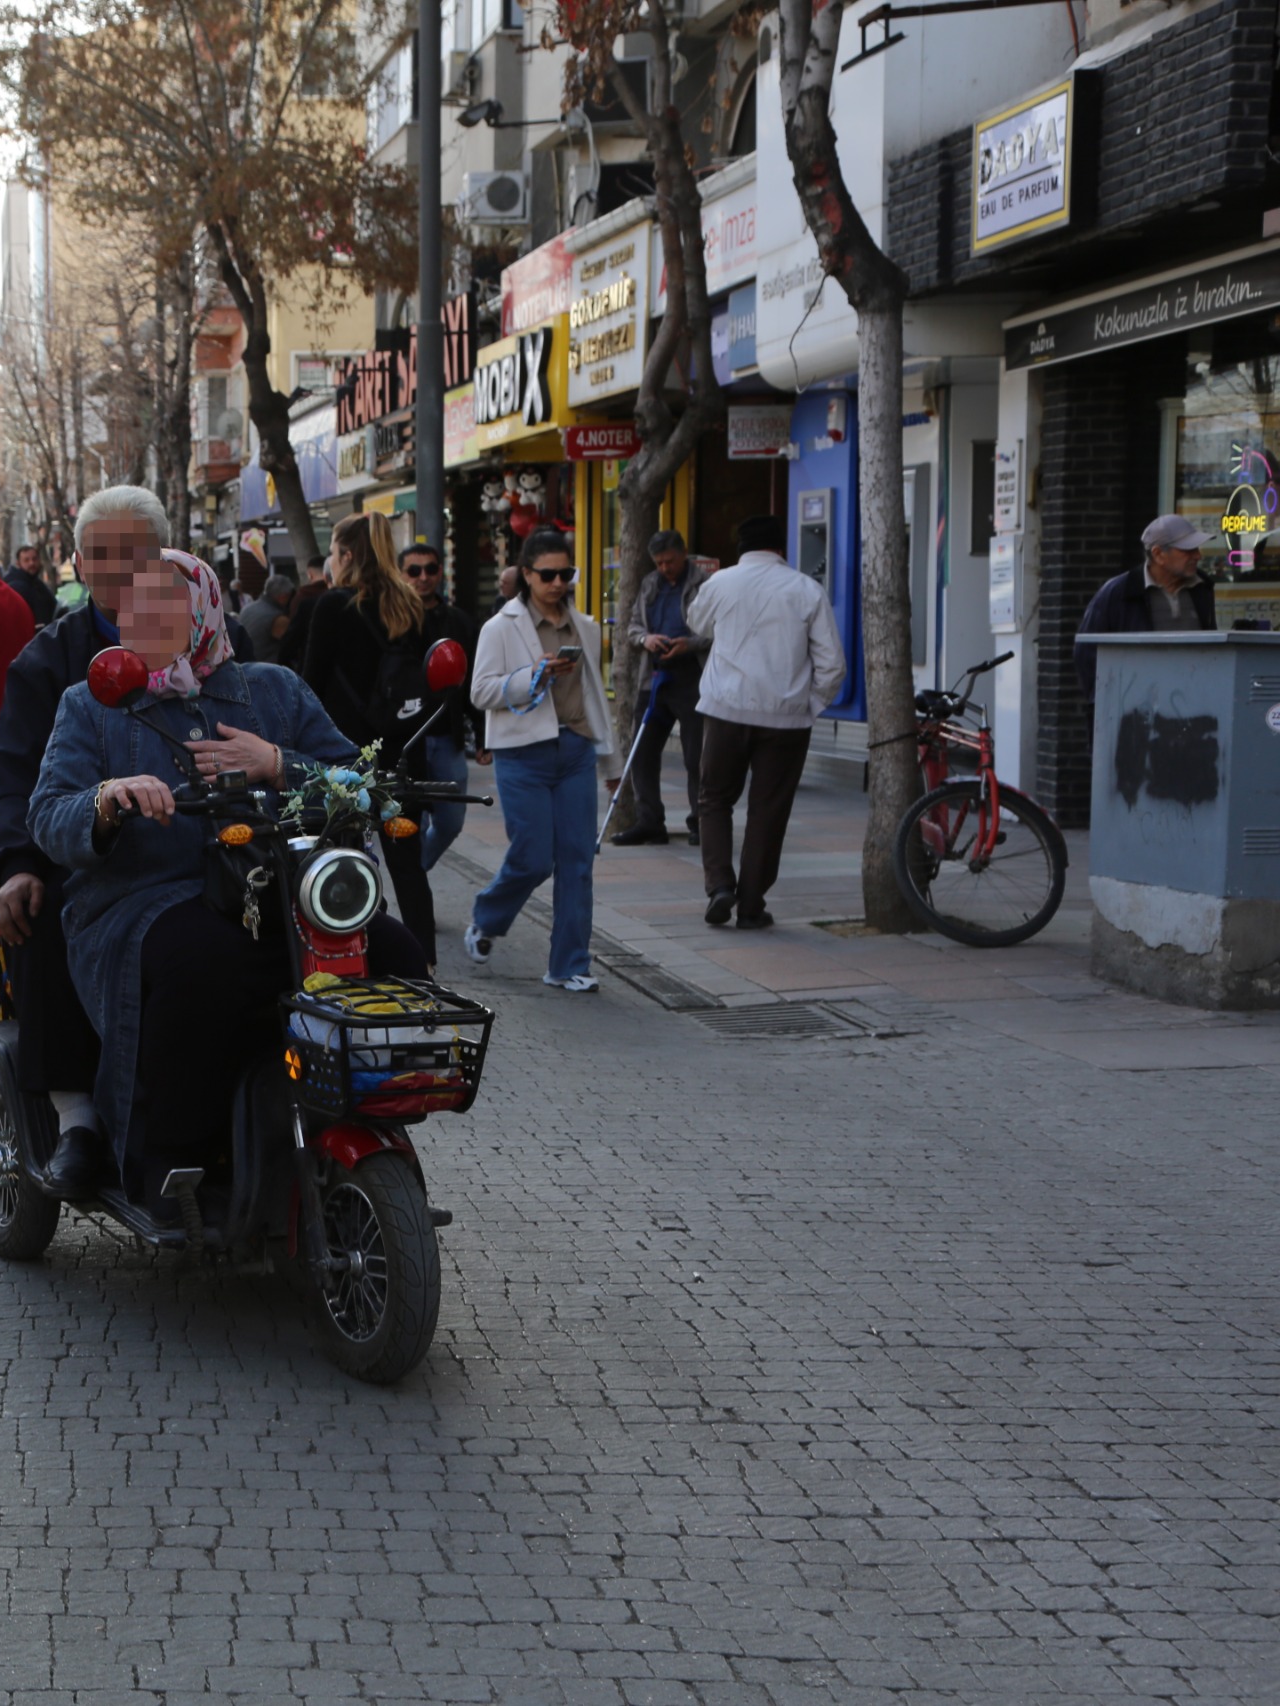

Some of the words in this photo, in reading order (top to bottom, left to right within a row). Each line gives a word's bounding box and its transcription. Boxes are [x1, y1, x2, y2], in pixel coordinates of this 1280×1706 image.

[980, 117, 1060, 185] DADYA
[980, 199, 997, 220] EAU
[1001, 192, 1013, 211] DE
[1018, 175, 1058, 204] PARFUM
[1093, 292, 1170, 341] Kokunuzla
[1173, 287, 1188, 319] iz
[1193, 273, 1262, 312] bırakın...
[576, 429, 633, 447] 4.NOTER
[1221, 513, 1268, 533] PERFUME
